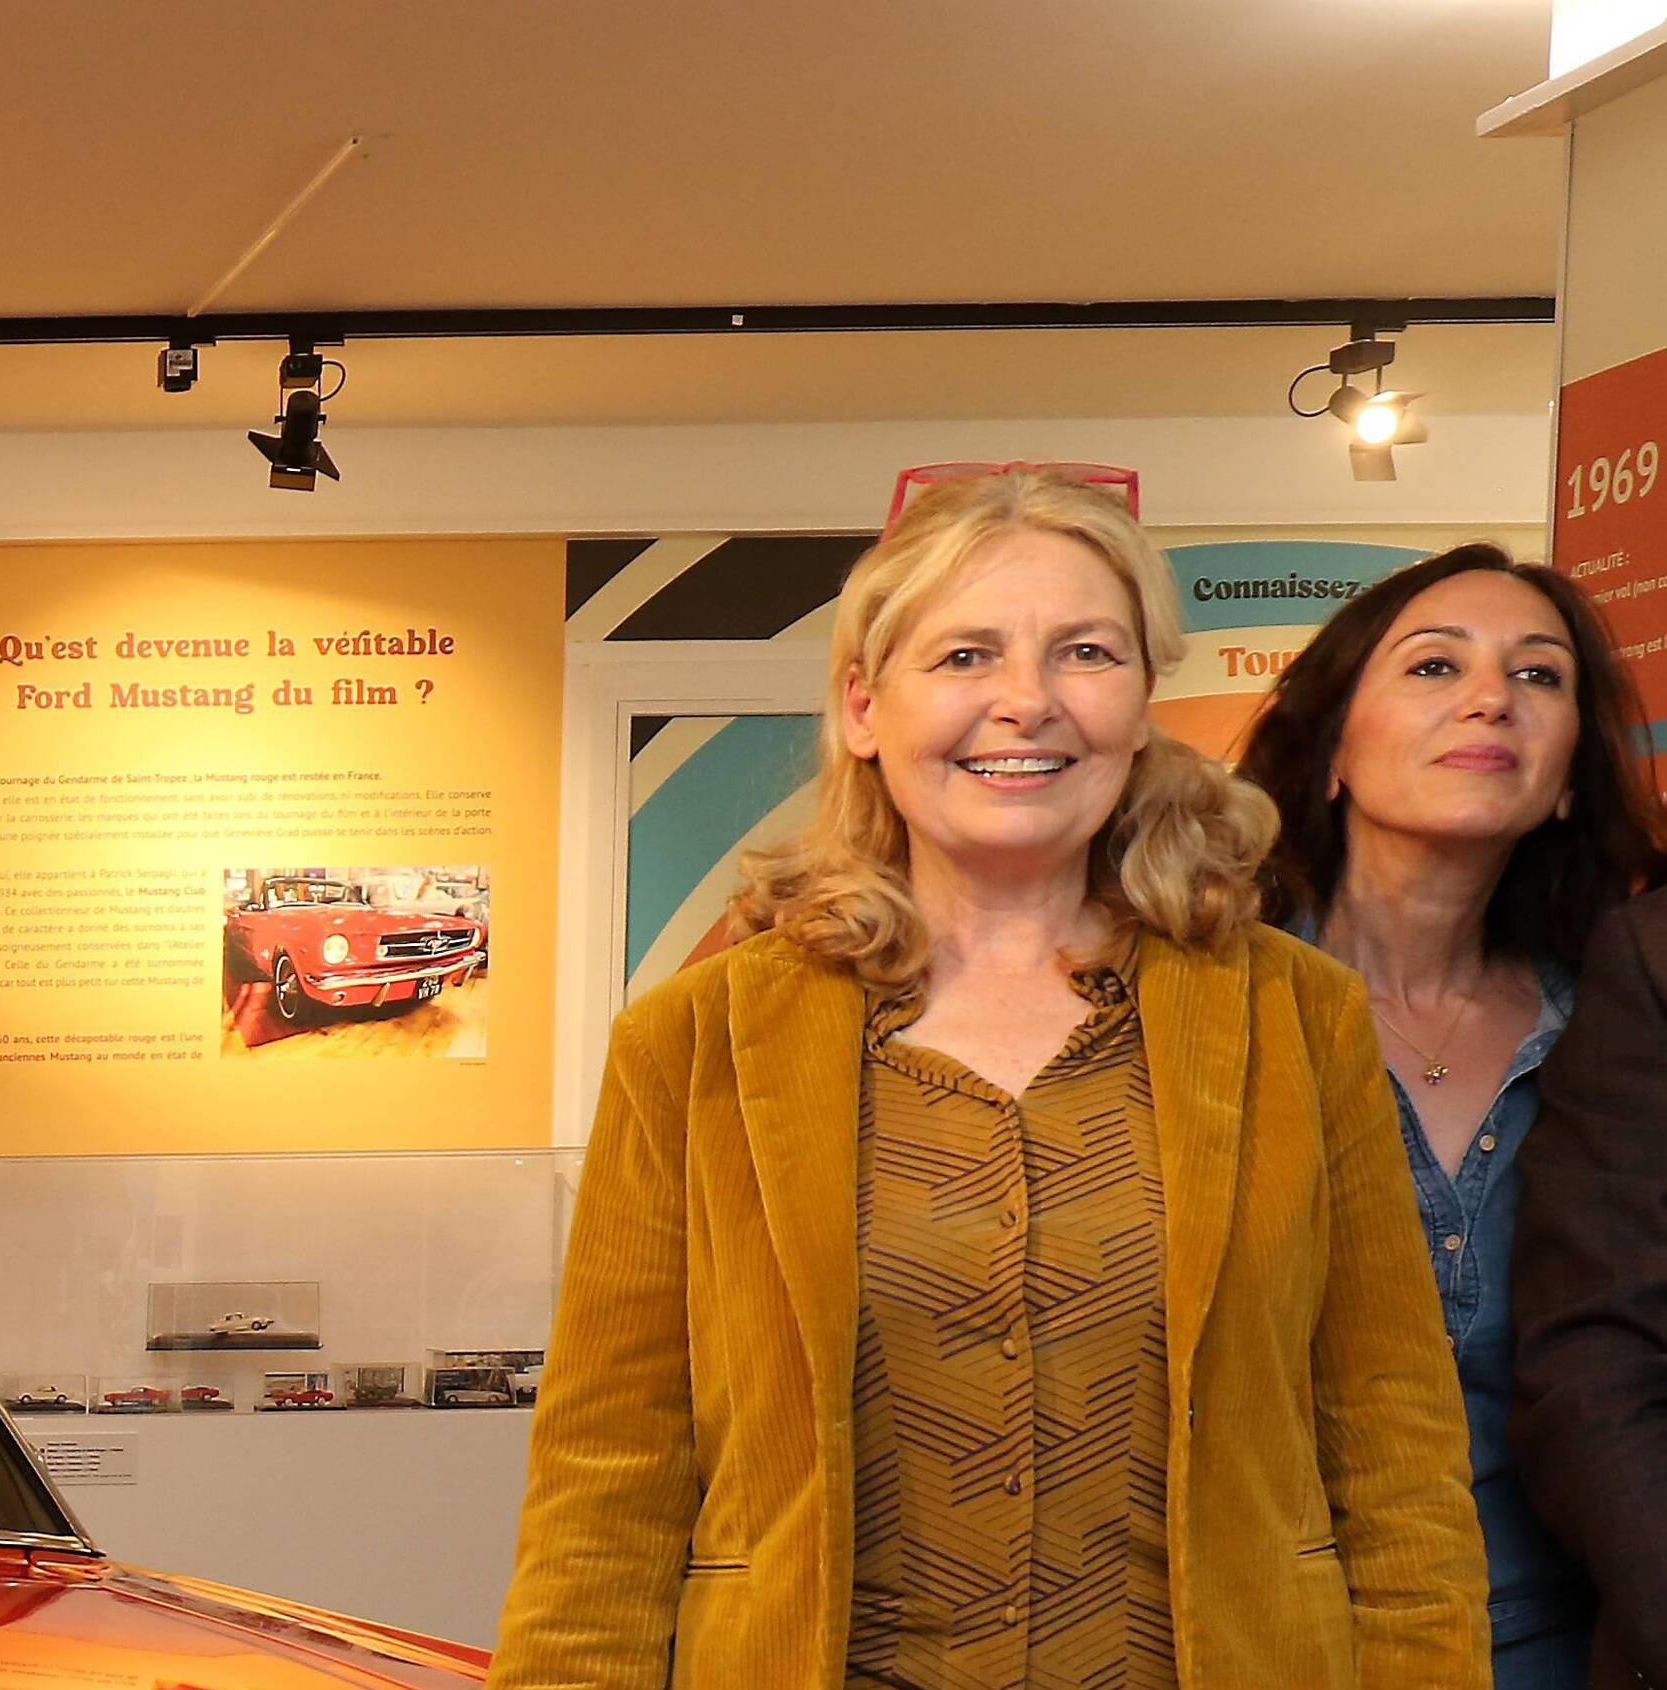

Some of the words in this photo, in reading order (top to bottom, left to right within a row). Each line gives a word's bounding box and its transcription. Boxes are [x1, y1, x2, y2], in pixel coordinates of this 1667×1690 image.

[1567, 441, 1659, 520] 1969
[115, 632, 250, 659] devenue
[267, 630, 296, 657] la
[313, 628, 455, 657] véritable
[16, 683, 92, 710] Ford
[110, 682, 255, 715] Mustang
[272, 680, 313, 706] du
[331, 678, 398, 706] film
[415, 679, 434, 705] ?
[43, 775, 56, 785] du
[58, 774, 108, 785] Gendarme
[111, 774, 124, 784] de
[448, 791, 492, 800] conserve
[464, 808, 492, 819] porte
[12, 1035, 33, 1046] ans,
[36, 1034, 60, 1044] cette
[64, 1033, 124, 1046] décapotable
[128, 1034, 157, 1046] rouge
[49, 1051, 92, 1065] Mustang
